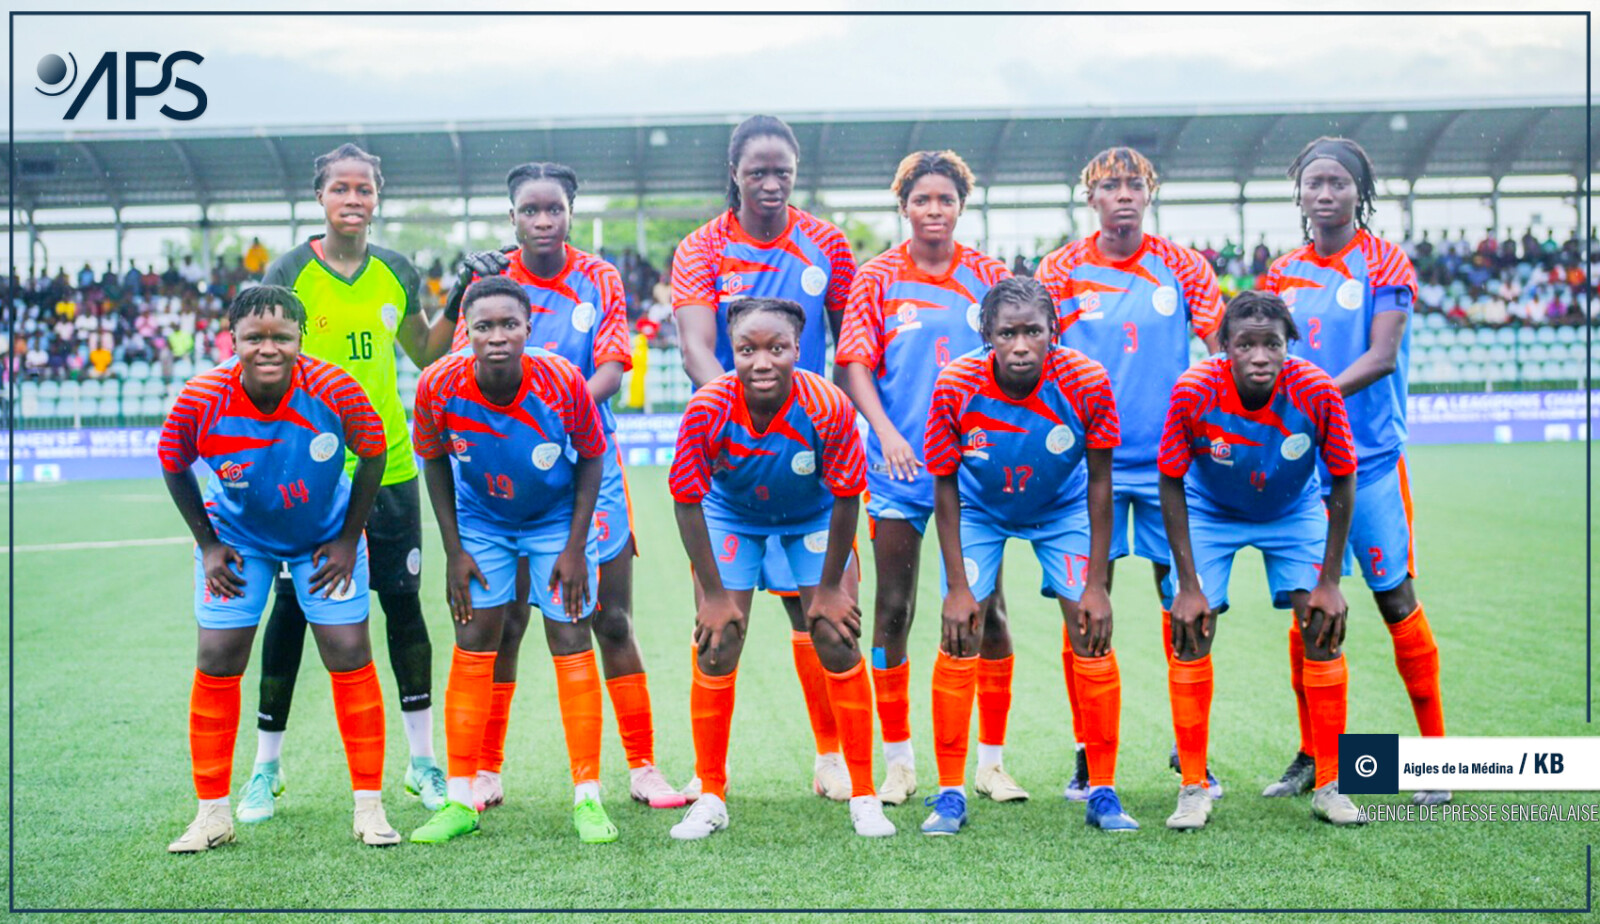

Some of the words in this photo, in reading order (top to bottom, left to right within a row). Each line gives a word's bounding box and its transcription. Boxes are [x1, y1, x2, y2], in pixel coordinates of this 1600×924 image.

[346, 331, 373, 361] 16
[1123, 321, 1138, 354] 3
[1307, 317, 1322, 349] 2
[935, 337, 950, 368] 6
[278, 478, 309, 509] 14
[484, 472, 514, 499] 19
[755, 485, 770, 501] 9
[1003, 465, 1034, 493] 17
[1250, 471, 1266, 492] 4
[594, 511, 610, 541] 5
[718, 533, 740, 563] 9
[1368, 547, 1386, 576] 2
